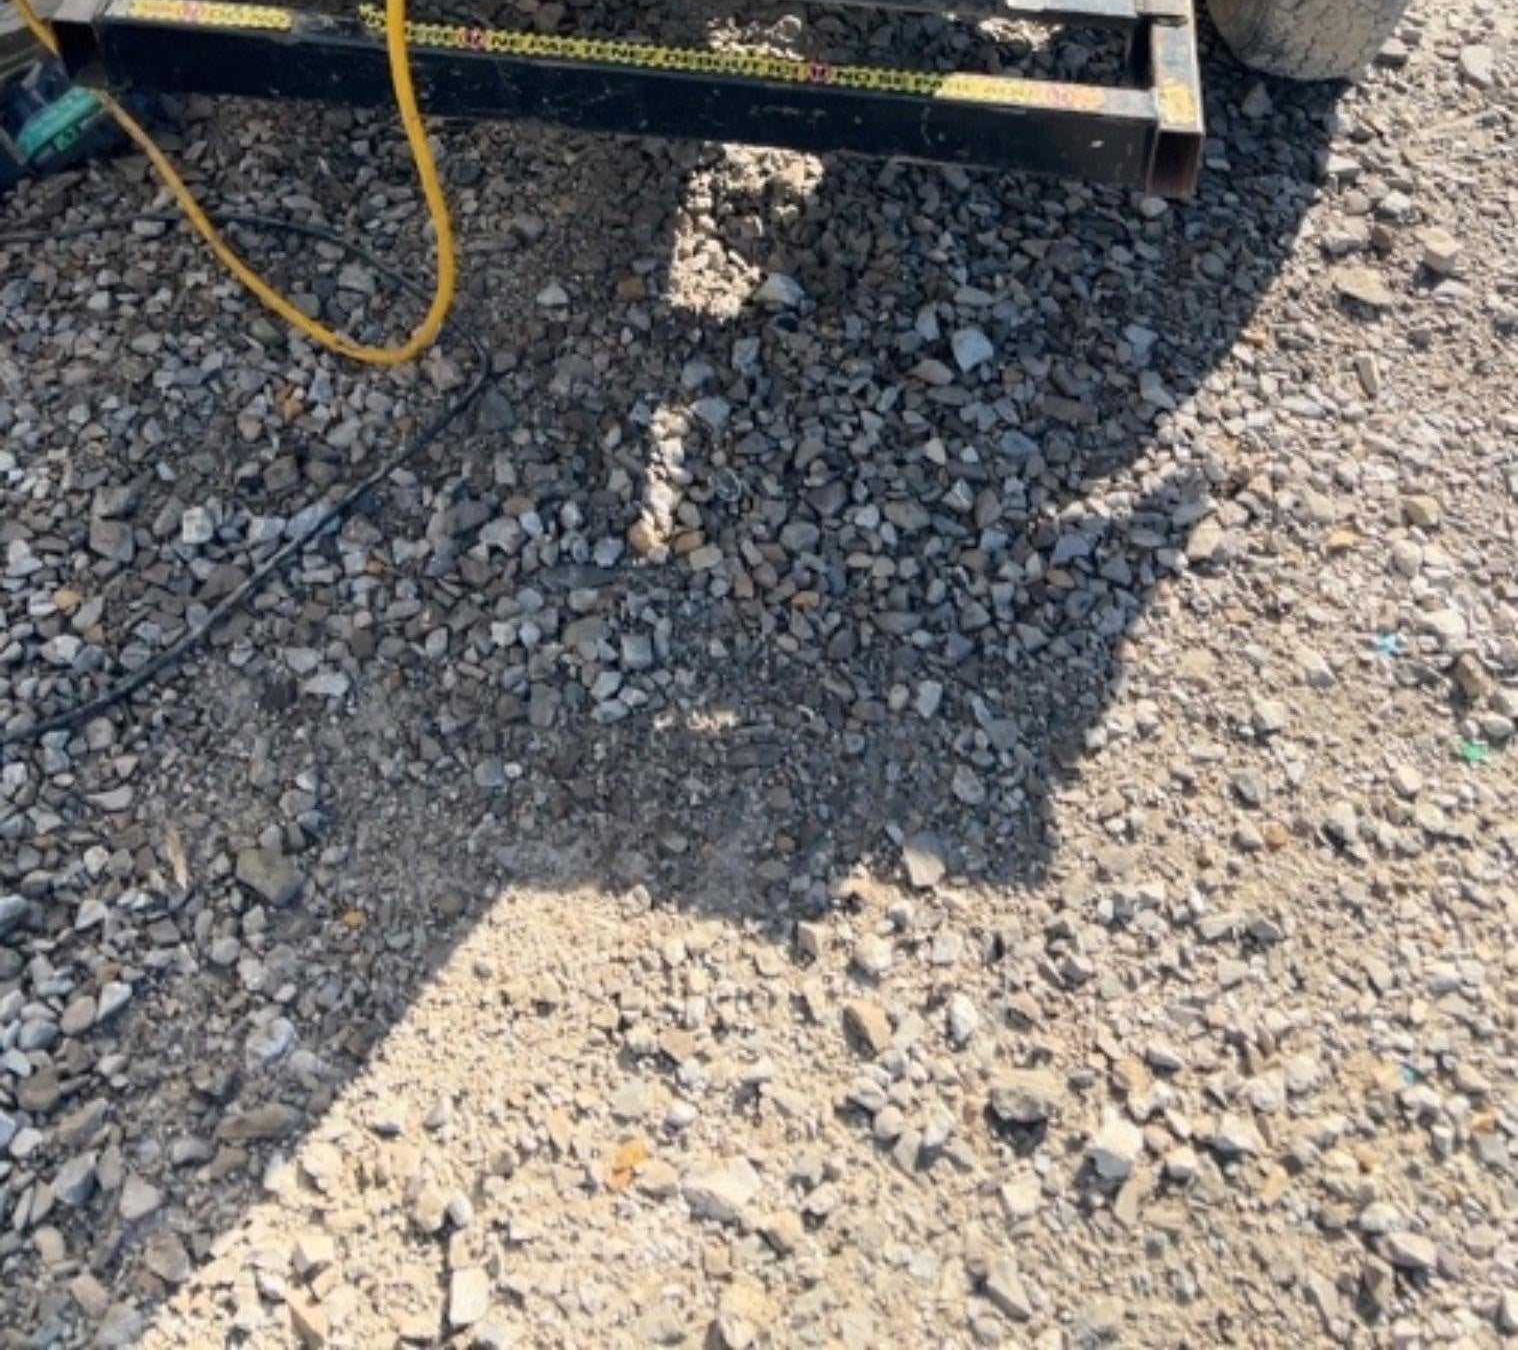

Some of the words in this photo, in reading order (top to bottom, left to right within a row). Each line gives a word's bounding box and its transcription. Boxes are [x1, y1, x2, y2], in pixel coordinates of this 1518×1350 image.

[493, 33, 523, 48] NE
[529, 36, 575, 53] PAS
[584, 42, 657, 60] TENEZ
[664, 49, 761, 70] DEBOUT
[836, 69, 871, 85] NO
[878, 72, 906, 87] SE
